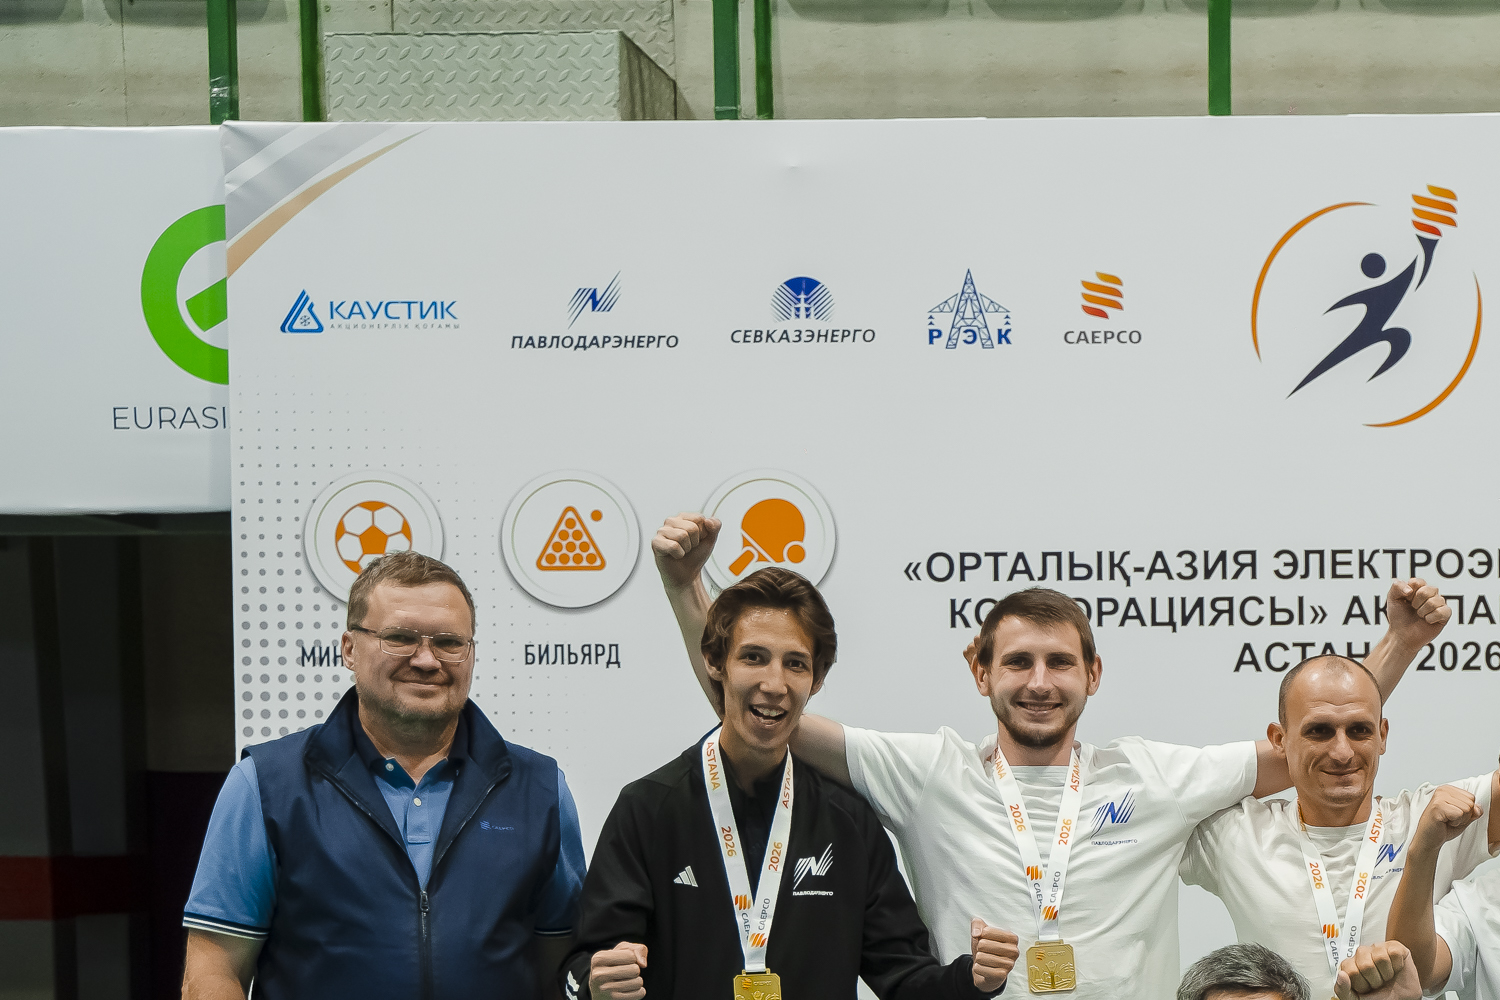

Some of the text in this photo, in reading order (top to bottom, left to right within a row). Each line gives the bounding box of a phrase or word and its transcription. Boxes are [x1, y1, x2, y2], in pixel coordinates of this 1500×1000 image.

[329, 301, 458, 320] КАУСТИК
[511, 334, 680, 351] ПАВЛОДАРЭНЕРГО
[730, 328, 876, 344] СЕВКАЗЭНЕРГО
[1063, 330, 1142, 345] CAEPCO
[113, 406, 230, 430] EURASI
[903, 549, 1258, 587] «ОРТАЛЫҚ-АЗИЯ
[524, 643, 621, 668] БИЛЬЯРД
[1009, 803, 1026, 832] 2026
[721, 825, 737, 858] 2026
[1058, 818, 1072, 846] 2026
[768, 841, 783, 872] 2026
[1050, 871, 1061, 903] CAEPCO
[1309, 862, 1325, 890] 2026
[1354, 872, 1368, 899] 2026
[758, 898, 771, 931] CAEPCO
[1346, 925, 1357, 958] CAEPCO
